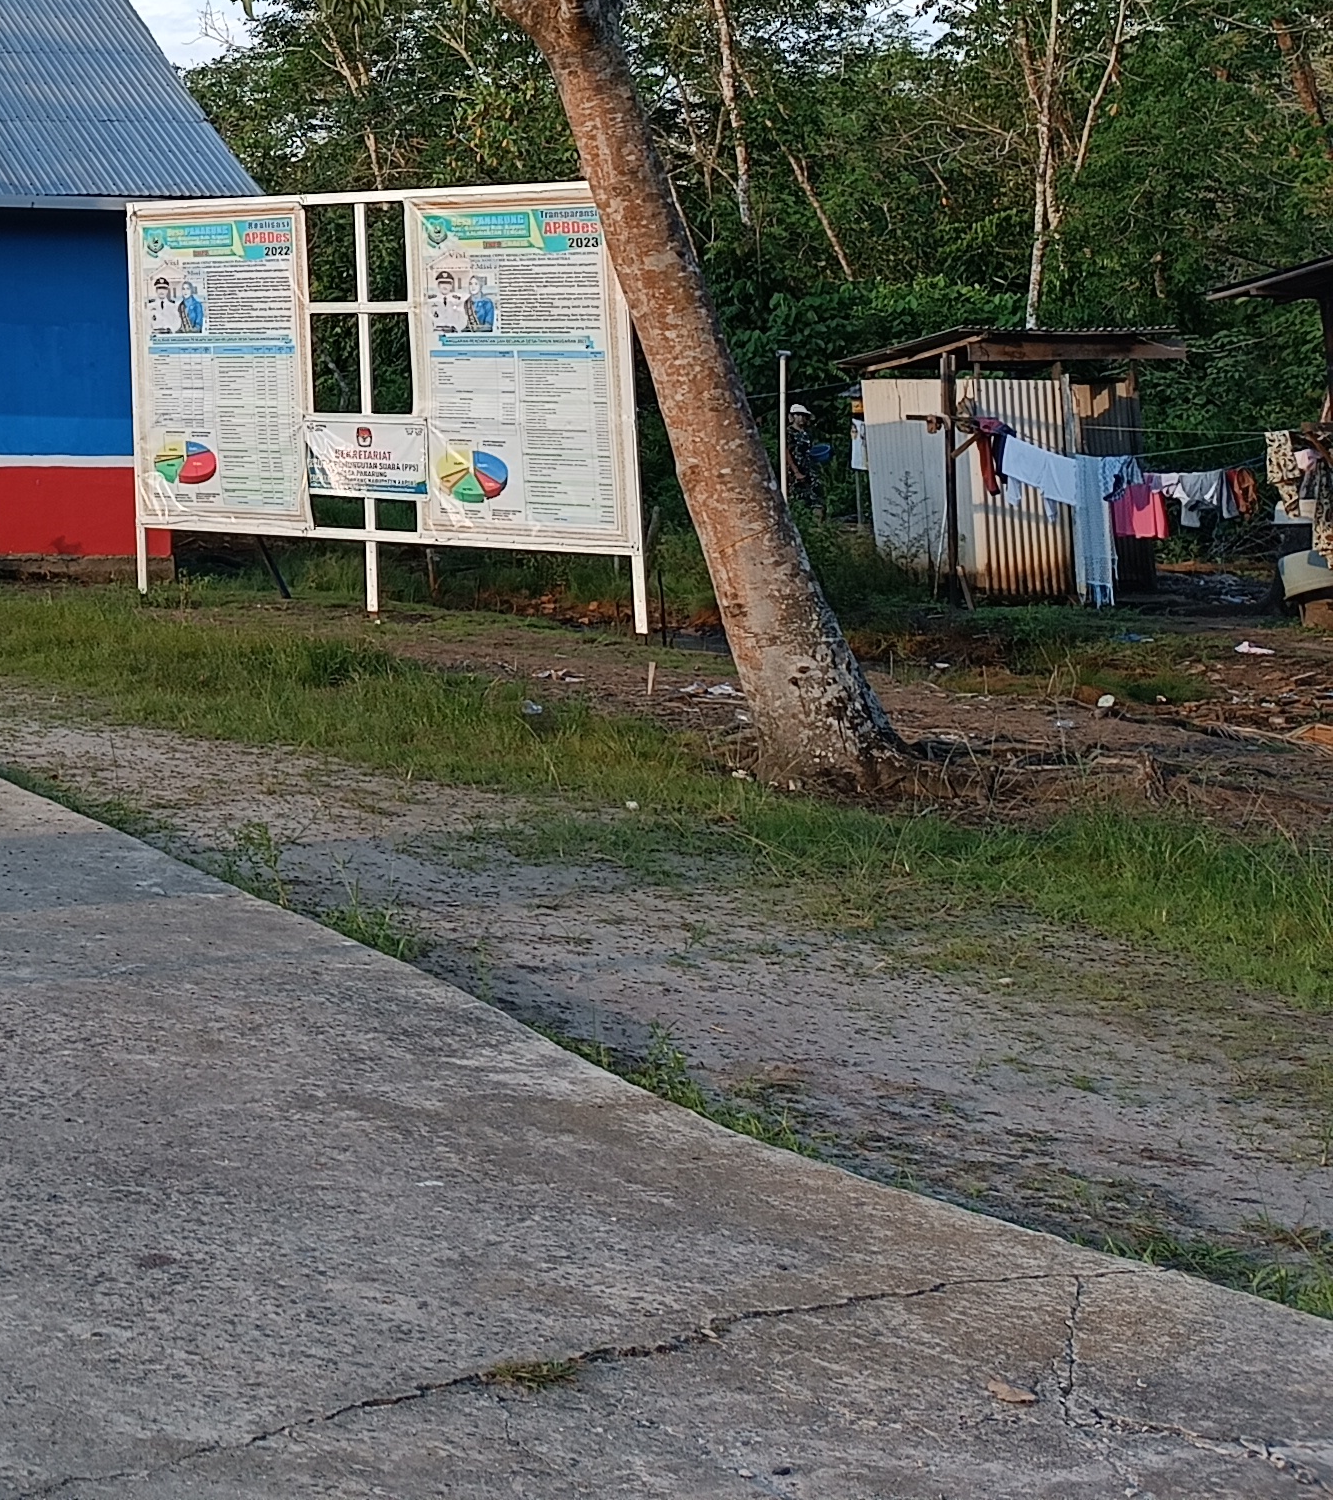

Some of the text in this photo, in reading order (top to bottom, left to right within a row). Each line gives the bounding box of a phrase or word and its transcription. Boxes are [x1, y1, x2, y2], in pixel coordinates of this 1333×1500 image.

[540, 209, 598, 219] Transparansi
[247, 221, 290, 229] Realisasi
[543, 220, 599, 235] APBDes
[244, 231, 290, 244] APBDes
[567, 236, 599, 248] 2023
[264, 246, 291, 256] 2022
